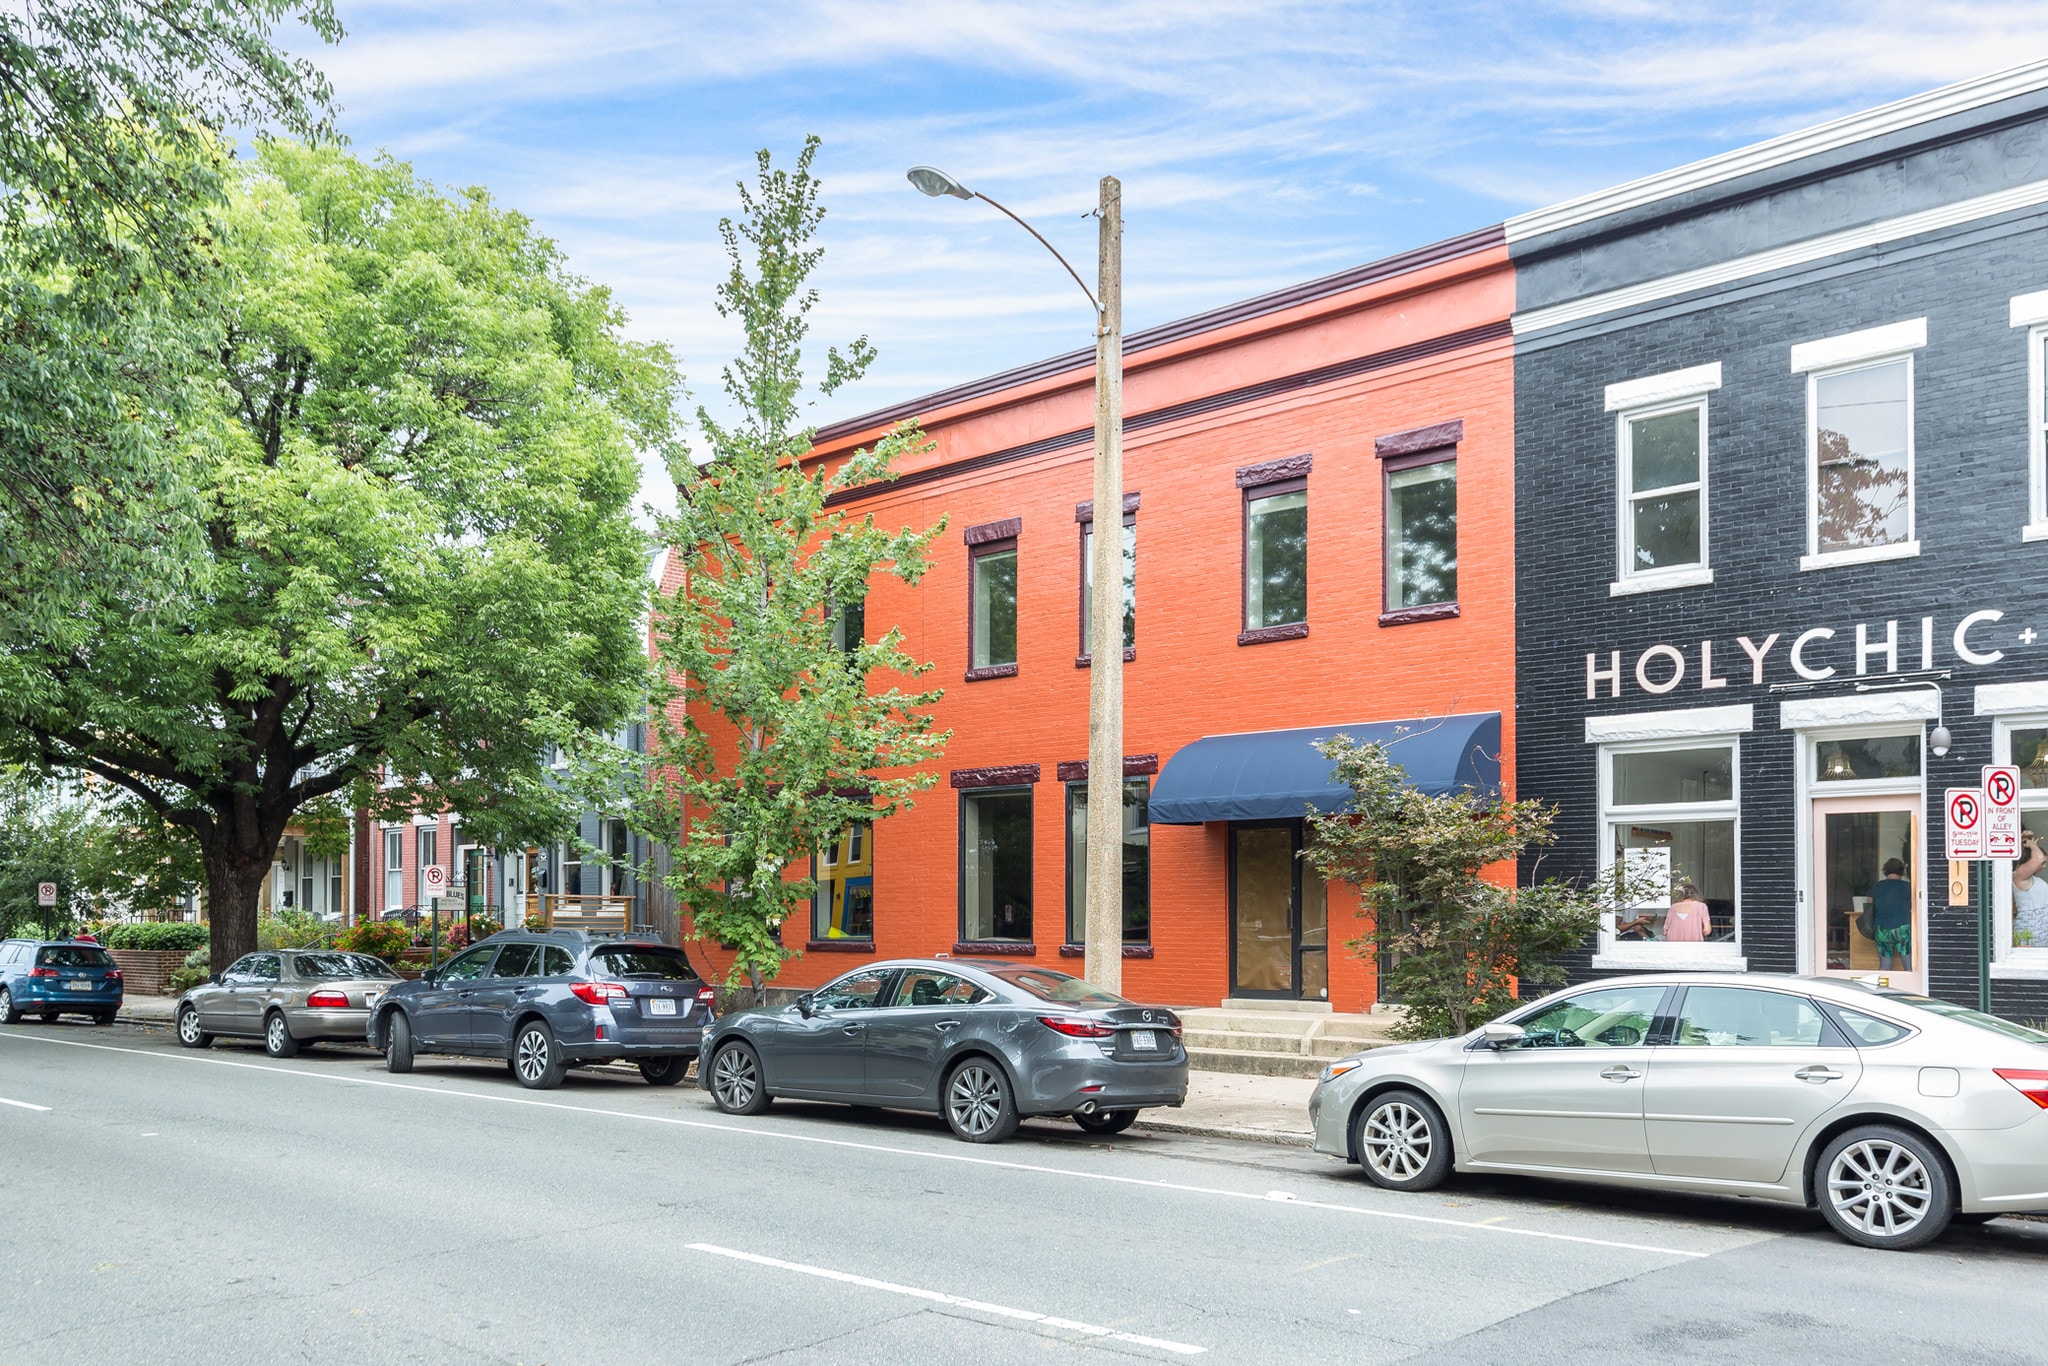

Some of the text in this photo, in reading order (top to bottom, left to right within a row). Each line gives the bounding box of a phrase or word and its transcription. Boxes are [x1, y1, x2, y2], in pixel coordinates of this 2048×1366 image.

[1995, 807, 2016, 815] FRONT
[1992, 823, 2013, 831] ALLEY
[1951, 838, 1979, 846] TUESDAY
[446, 890, 465, 900] BLUES
